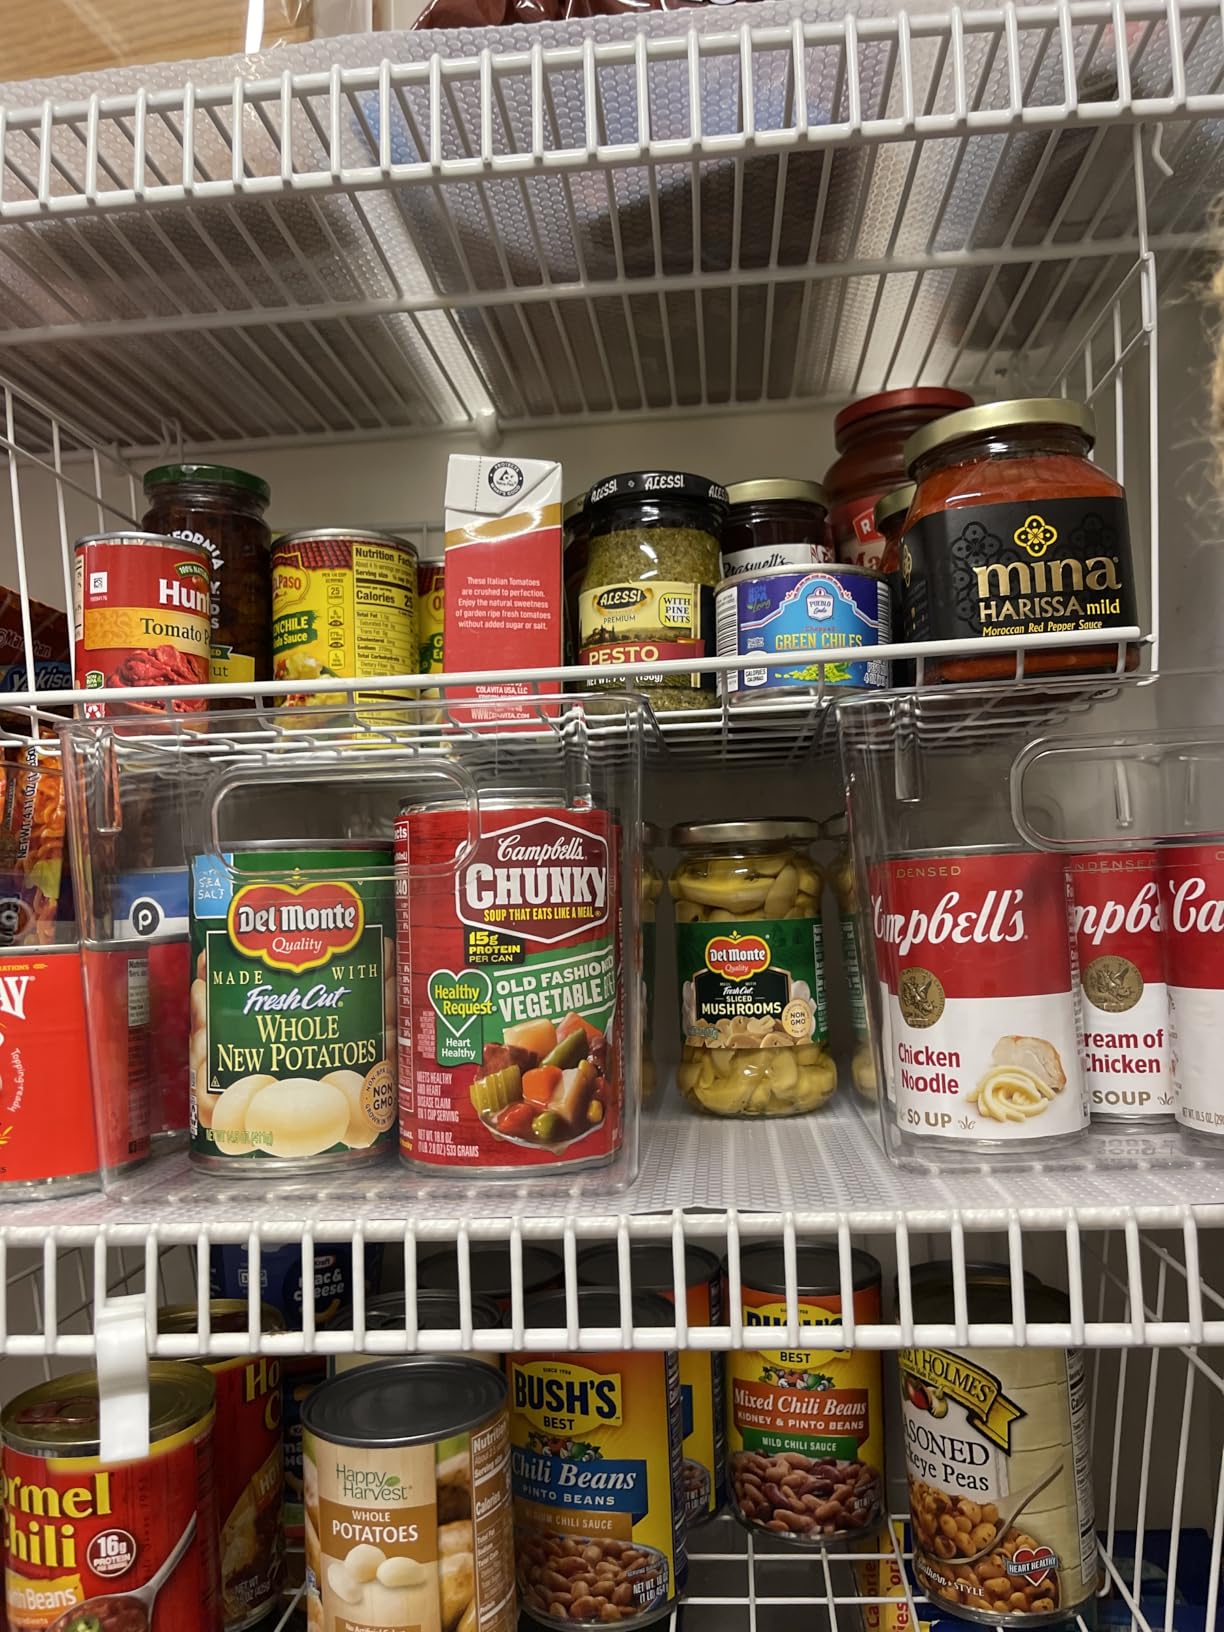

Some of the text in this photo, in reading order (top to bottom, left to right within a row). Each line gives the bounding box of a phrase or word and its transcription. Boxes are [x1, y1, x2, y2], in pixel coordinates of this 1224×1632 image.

[590, 479, 618, 502] ALESSI
[645, 474, 685, 491] ALESSI
[355, 547, 395, 561] Nutrition
[467, 577, 540, 587] These Italian Tomatoes
[972, 556, 1122, 598] mina
[356, 590, 395, 604] Calories
[474, 588, 500, 597] crushed
[501, 589, 509, 597] to
[510, 589, 546, 598] perfection.
[600, 590, 641, 607] ALESSI
[663, 598, 691, 606] WITH
[458, 599, 548, 609] Enjoy the natural sweetness
[665, 606, 690, 614] PINE
[979, 595, 1120, 623] HARISSA mild
[463, 610, 487, 619] garden
[488, 610, 501, 618] ripe
[502, 610, 519, 618] fresh
[520, 612, 551, 620] tomatoes
[603, 615, 636, 625] PREMIUM
[664, 614, 690, 624] NUTS
[140, 617, 201, 641] Tomato
[458, 621, 484, 629] without
[485, 621, 504, 629] added
[506, 622, 524, 631] sugar
[533, 622, 548, 630] salt.
[983, 619, 1103, 637] Moroccan Red Pepper Sauce
[775, 632, 817, 651] GREEN
[588, 645, 659, 666] PESTO
[12, 666, 72, 692] Ykiso
[476, 686, 503, 694] COLAVITA
[498, 834, 585, 866] Campbell's
[895, 865, 962, 879] DENSED
[465, 862, 607, 910] CHUNKY
[483, 906, 594, 922] SOUP THAT EATS LIKE A MEAL
[1169, 877, 1224, 933] Ca
[238, 903, 356, 933] Del Monte
[272, 937, 323, 955] Quality
[469, 931, 499, 946] 15g
[468, 945, 521, 954] PROTEIN
[469, 954, 513, 963] PER CAN
[709, 948, 766, 962] Del Monte
[213, 964, 379, 986] MADE WITH
[725, 963, 749, 973] Quality
[434, 983, 480, 1002] Healthy
[496, 976, 537, 996] OLD
[243, 984, 352, 1015] Fresh Cut
[499, 978, 603, 1023] VEGETABLE
[725, 995, 753, 1003] SLICED
[443, 999, 493, 1018] Request
[701, 1002, 782, 1015] MUSHROOMS
[790, 1011, 805, 1019] NON
[256, 1014, 340, 1043] WHOLE
[790, 1018, 806, 1026] GMO
[446, 1037, 472, 1048] Heart
[1083, 1028, 1164, 1049] ream of
[217, 1039, 376, 1072] NEW POTATOES
[441, 1047, 476, 1060] Healthy
[897, 1042, 961, 1068] Chicken
[373, 1082, 393, 1098] NON
[901, 1068, 960, 1095] Noodle
[373, 1096, 393, 1110] GMO
[1092, 1089, 1151, 1106] SOUP
[907, 1108, 952, 1128] SOUP
[446, 1144, 479, 1158] 533 GRAMS
[293, 1282, 345, 1301] ceese
[780, 1352, 811, 1364] BEST
[922, 1352, 992, 1403] HOLMES
[514, 1369, 618, 1420] BUSH'S
[734, 1388, 867, 1417] Mixed Chili Beans
[543, 1415, 575, 1431] BEST
[737, 1411, 865, 1431] KIDNEY & PINTO BEANS
[762, 1437, 837, 1452] MILD CHILI SAUCE
[904, 1414, 990, 1467] SONED
[336, 1463, 387, 1488] Happy
[513, 1451, 637, 1491] Chili Beans
[942, 1462, 990, 1492] Peas
[0, 1470, 112, 1519] rmel
[343, 1482, 408, 1501] Harvest
[522, 1485, 615, 1506] PINTO BEANS
[351, 1509, 391, 1522] WHOLE
[556, 1515, 579, 1528] CHILI
[582, 1519, 613, 1530] SAUCE
[332, 1520, 419, 1543] POTATOES
[97, 1535, 127, 1558] 16g
[93, 1553, 131, 1567] PROTEIN
[1009, 1556, 1057, 1573] HEART HEALTHY
[25, 1587, 77, 1610] Beans
[954, 1582, 985, 1597] STYLE
